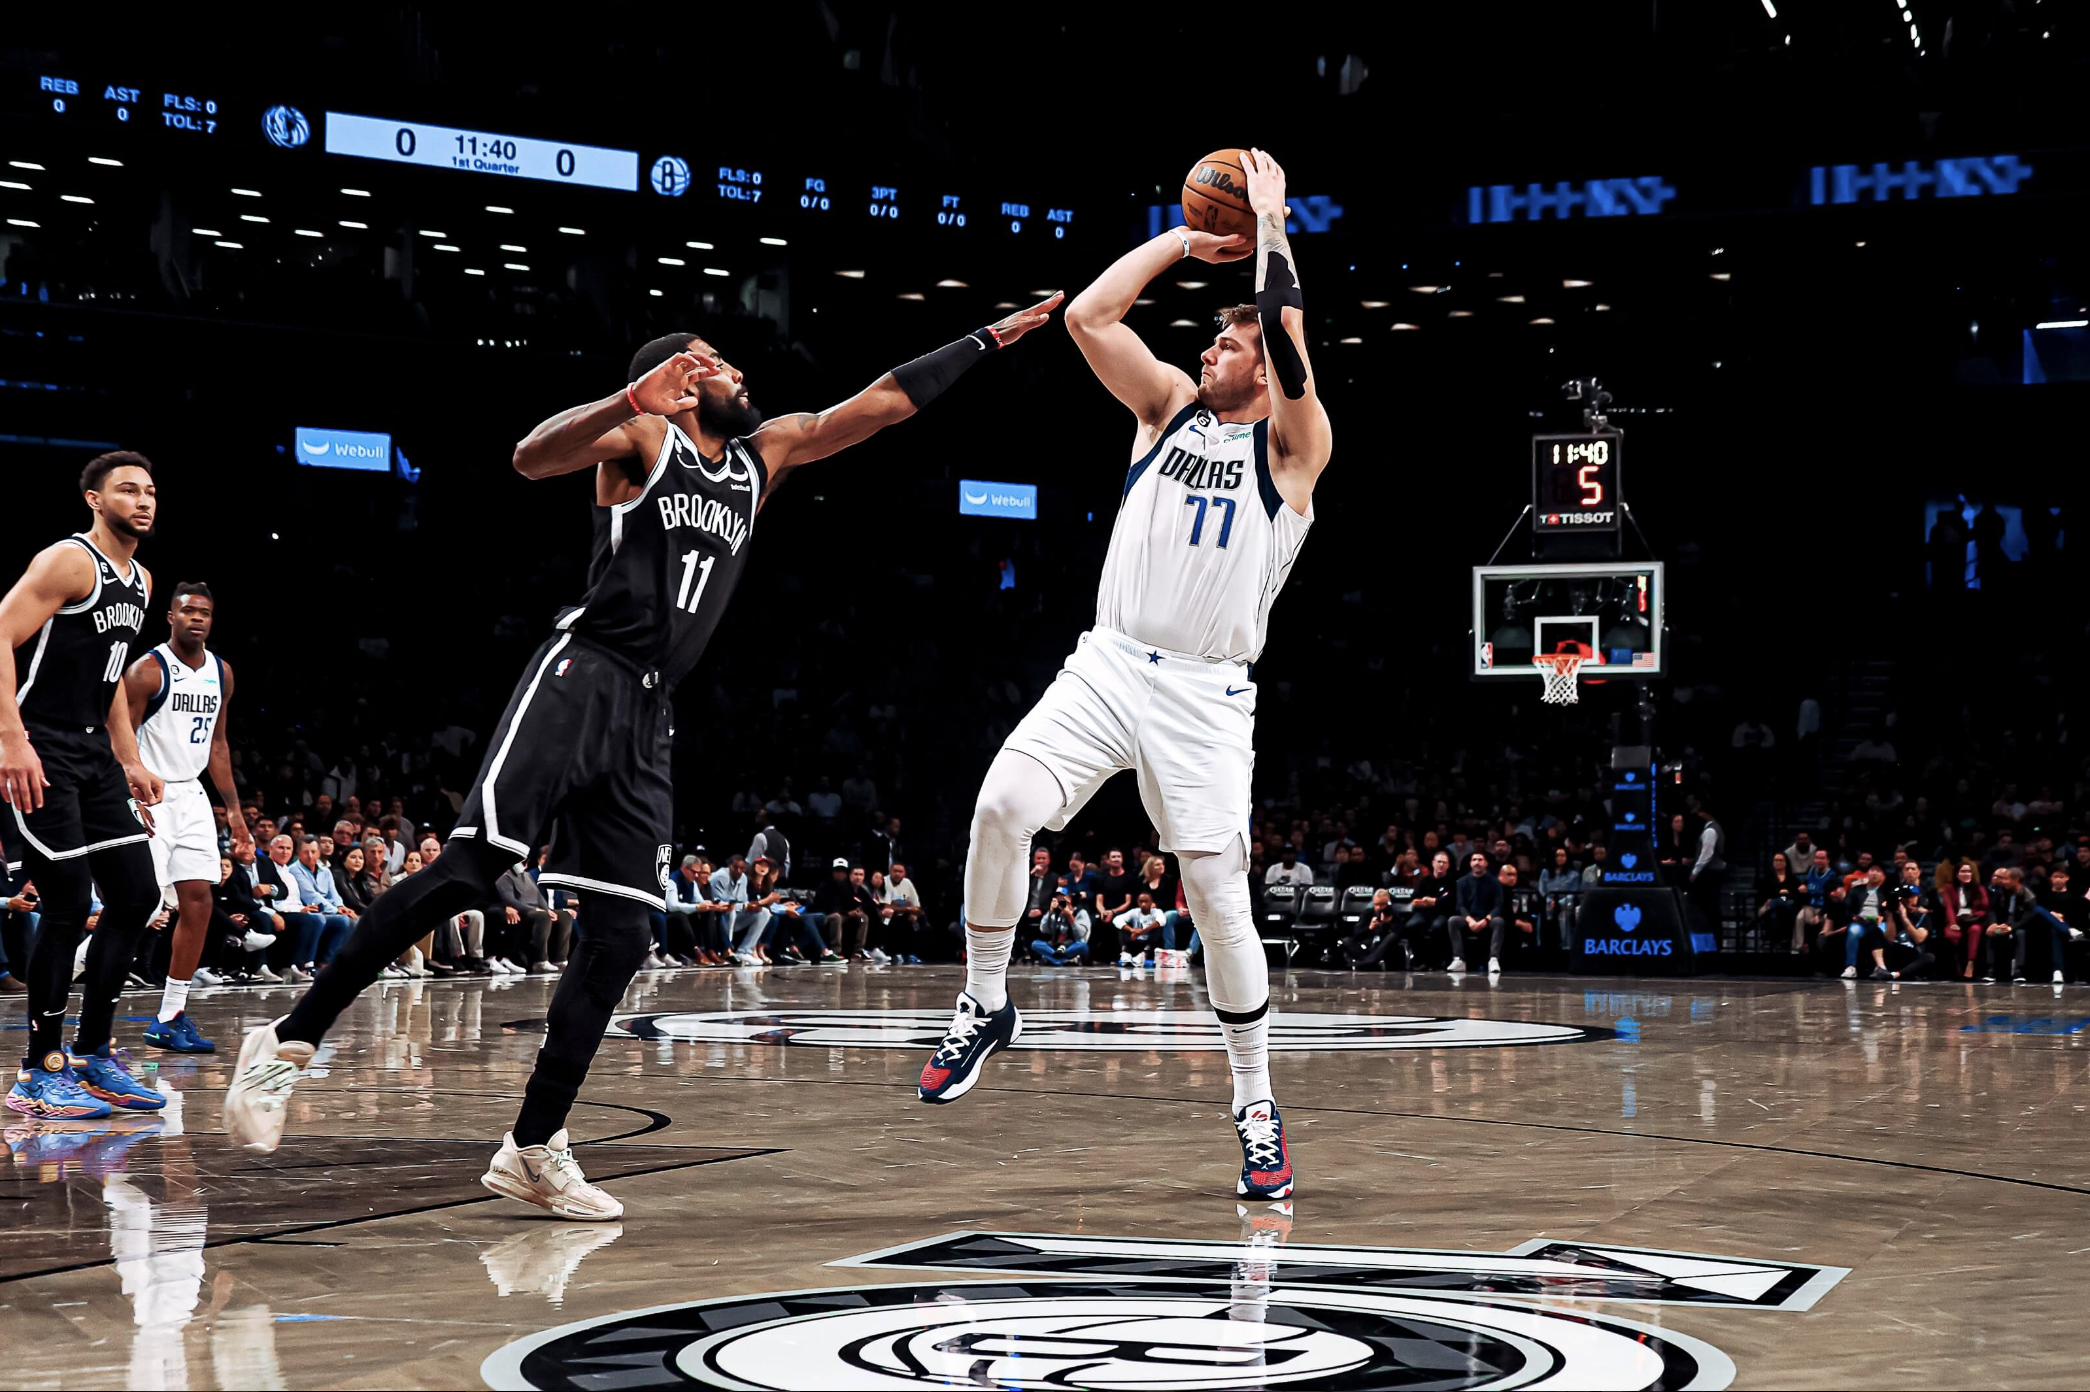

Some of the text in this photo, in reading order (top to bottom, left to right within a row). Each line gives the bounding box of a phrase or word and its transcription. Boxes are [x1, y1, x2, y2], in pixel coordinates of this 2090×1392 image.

[40, 76, 79, 95] REB
[104, 85, 140, 102] AST
[53, 99, 66, 113] 0
[163, 94, 217, 114] FLS: 0
[117, 107, 129, 121] 0
[162, 112, 217, 133] TOL: 7
[395, 128, 416, 157] 0
[455, 135, 517, 161] 11:40
[452, 156, 520, 175] 1st Quarter
[556, 149, 576, 177] 0
[719, 167, 762, 185] FLS: 0
[806, 178, 825, 192] FG
[1196, 166, 1248, 200] Wilso
[718, 184, 762, 203] TOL: 7
[872, 186, 897, 201] 3PT
[943, 195, 960, 208] FT
[1002, 202, 1030, 217] REB
[1047, 209, 1073, 222] AST
[1011, 221, 1021, 233] 0
[1055, 226, 1064, 239] 0
[335, 442, 384, 459] Webull
[1552, 440, 1608, 465] 11:40
[1158, 446, 1245, 490] DALLAS
[1578, 466, 1603, 505] 5
[991, 494, 1031, 508] Webull
[657, 493, 748, 556] BROOKLYN
[1185, 494, 1236, 550] 77
[676, 549, 716, 614] 11
[92, 602, 145, 636] BROOKLY
[102, 640, 129, 683] 10
[172, 692, 218, 714] DALLAS
[190, 716, 213, 744] 25
[1604, 872, 1655, 882] BARCLAYS
[1584, 938, 1673, 957] BARCLAYS
